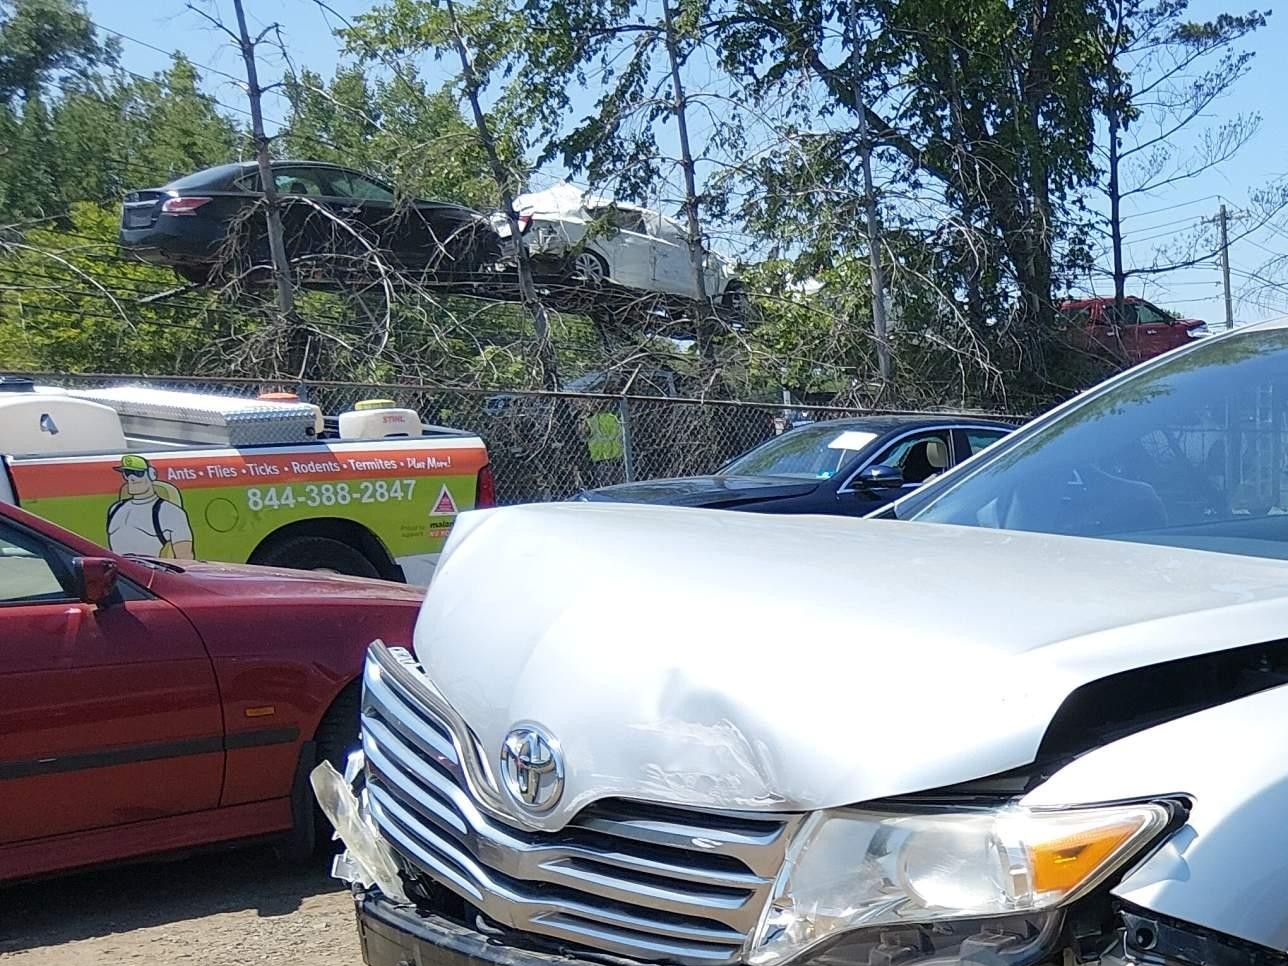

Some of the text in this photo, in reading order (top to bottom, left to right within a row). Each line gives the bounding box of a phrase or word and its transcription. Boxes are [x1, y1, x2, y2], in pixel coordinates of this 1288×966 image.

[167, 467, 197, 481] Ants
[206, 464, 238, 479] Flies
[244, 463, 280, 477] Ticks
[291, 461, 341, 474] Rodents
[347, 458, 398, 471] Termites
[247, 479, 417, 512] 844-388-2847
